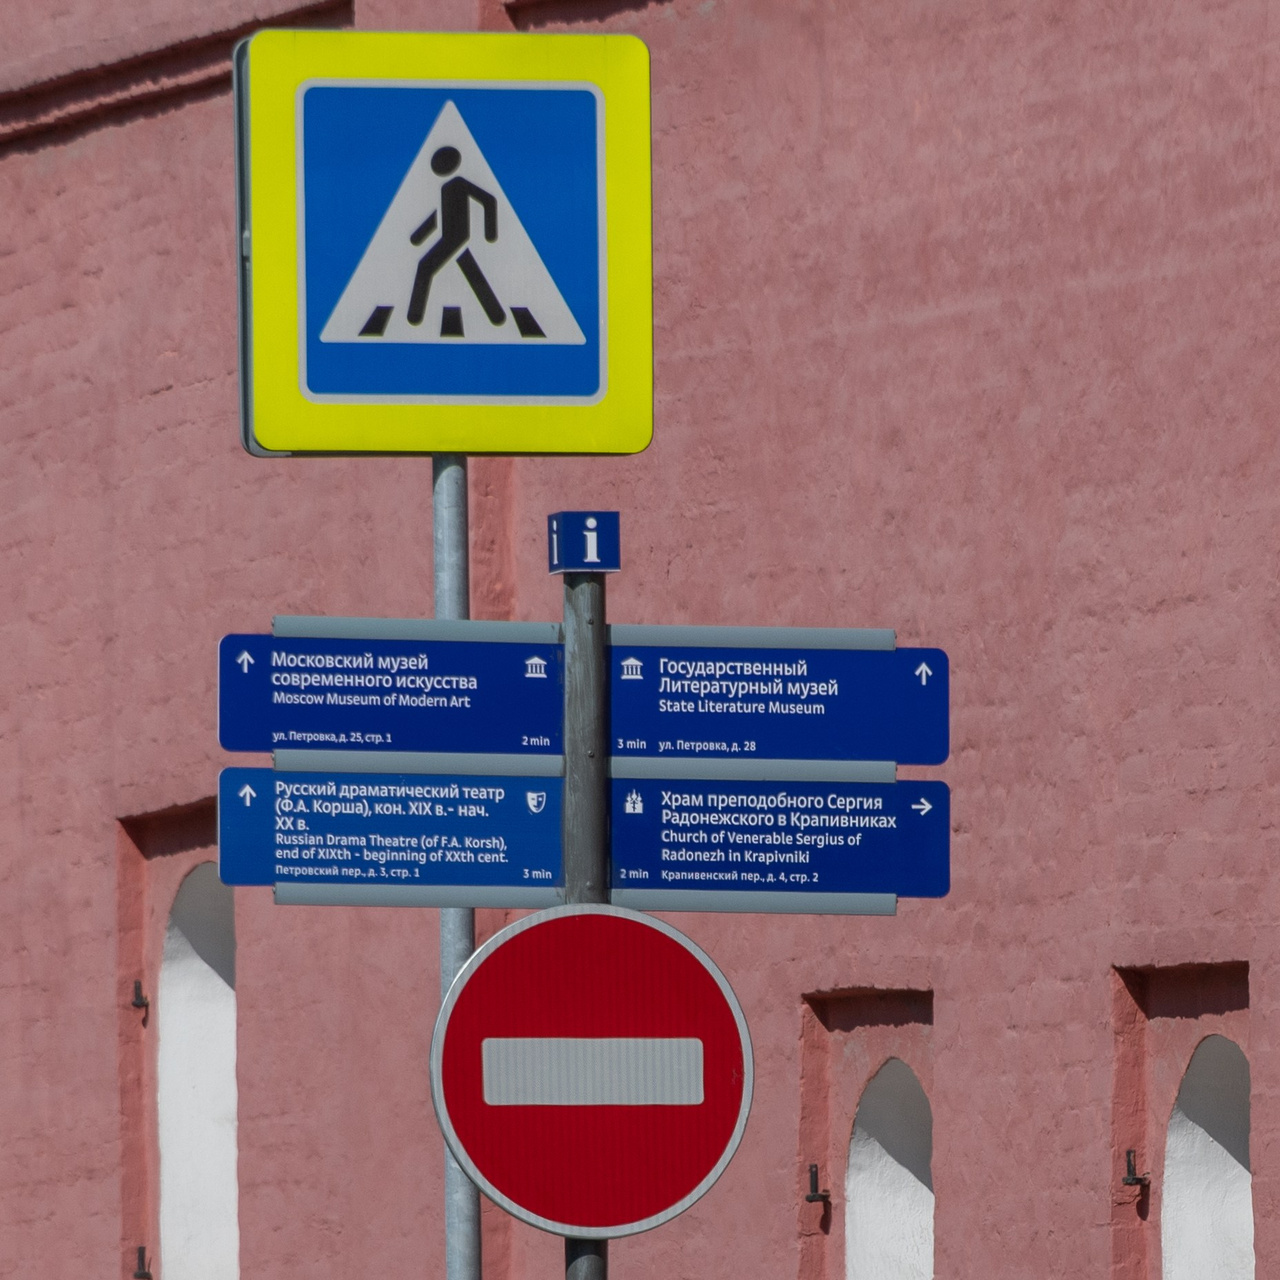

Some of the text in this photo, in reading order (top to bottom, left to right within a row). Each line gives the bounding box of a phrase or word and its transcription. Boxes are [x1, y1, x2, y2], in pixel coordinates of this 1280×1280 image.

[272, 652, 428, 673] Московский музей
[660, 658, 806, 678] Государственный
[272, 673, 477, 692] современного искусства
[659, 678, 838, 699] Литературный музей
[274, 692, 470, 708] Moscow Museum of Modern Art
[660, 700, 824, 714] State Literature Museum
[273, 732, 287, 742] ул.
[350, 732, 364, 743] 25,
[365, 734, 384, 744] стр.
[386, 734, 392, 742] 1
[522, 736, 550, 746] 2 min
[618, 739, 646, 748] 3 min
[659, 740, 756, 752] ул. Петровка, д. 28
[276, 781, 504, 803] Русский драматический театр
[276, 797, 309, 815] (Ф.А.
[313, 799, 372, 817] Корша),
[375, 803, 406, 814] кон.
[409, 802, 432, 815] XIX
[458, 805, 488, 816] нач.
[662, 792, 882, 812] Храм преподобного Сергия
[276, 816, 309, 830] XX в.
[662, 810, 896, 830] Радонежского в Крапивниках
[276, 833, 507, 851] Russian Drama Theatre (of F.A. Korsh),
[662, 830, 862, 848] Church of Venerable Sergius of
[276, 847, 298, 858] end
[302, 847, 316, 859] of
[318, 848, 351, 860] XIXth
[364, 848, 426, 864] beginning
[430, 850, 443, 862] of
[445, 851, 474, 862] XXth
[478, 852, 508, 862] cent.
[662, 848, 809, 864] Radonezh in Krapivniki
[276, 865, 338, 876] Петровский
[367, 868, 378, 877] д.
[380, 867, 388, 878] 3,
[390, 869, 411, 879] стр.
[414, 868, 419, 877] 1
[524, 869, 552, 878] 3 min
[620, 869, 648, 878] 2 min
[662, 870, 738, 881] Крапивенский
[766, 874, 776, 882] д.
[779, 872, 787, 882] 4,
[790, 874, 810, 884] стр.
[813, 872, 818, 882] 2
